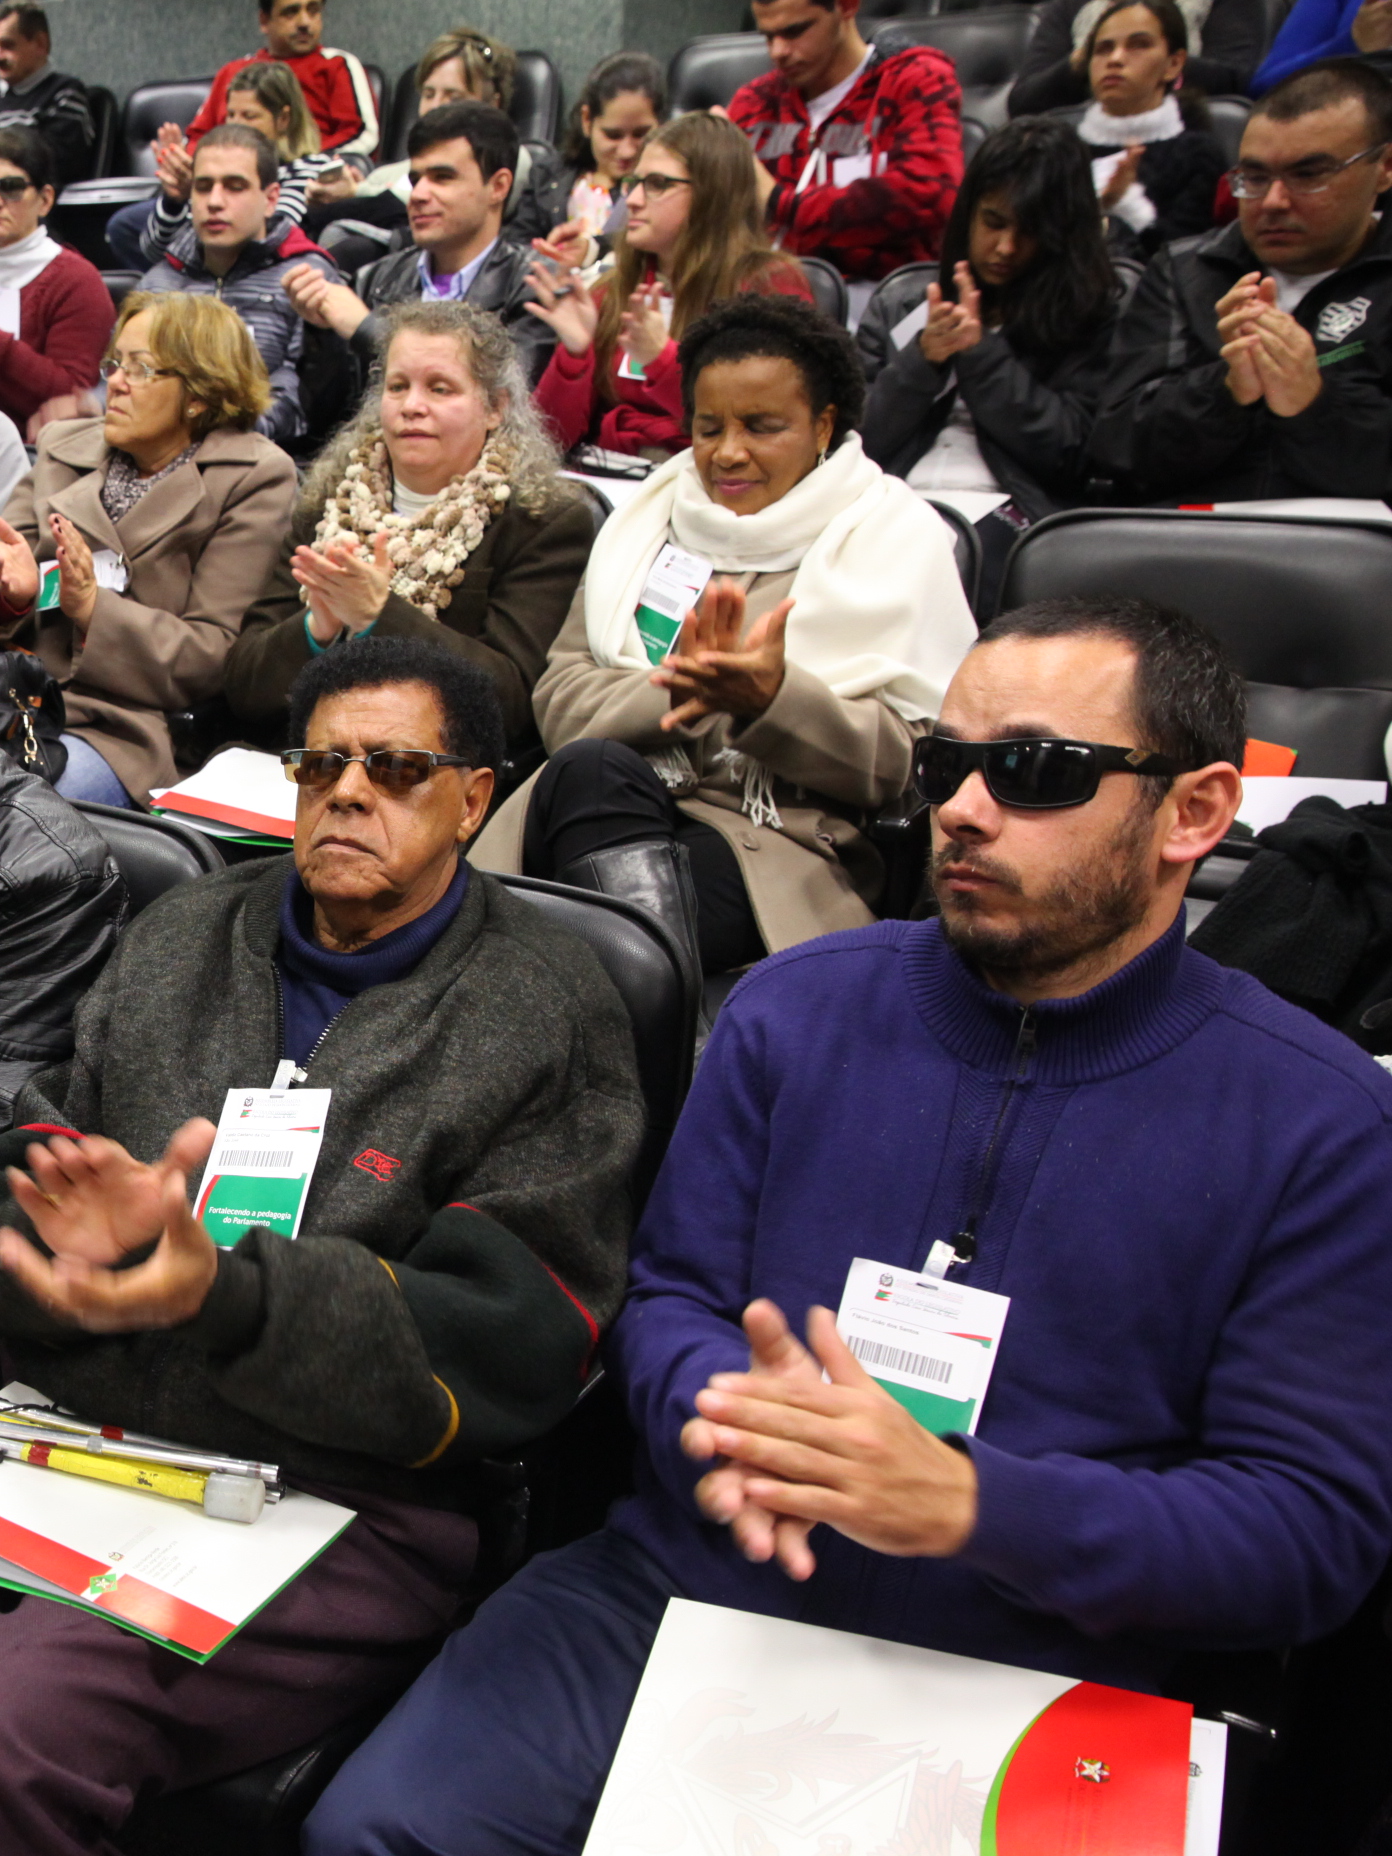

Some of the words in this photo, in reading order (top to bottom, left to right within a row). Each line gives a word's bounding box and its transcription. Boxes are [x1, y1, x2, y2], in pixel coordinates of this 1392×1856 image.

[208, 1206, 251, 1216] Fortalecendo
[257, 1210, 292, 1220] pedagogia
[222, 1216, 232, 1224] do
[232, 1217, 271, 1227] Parlamento
